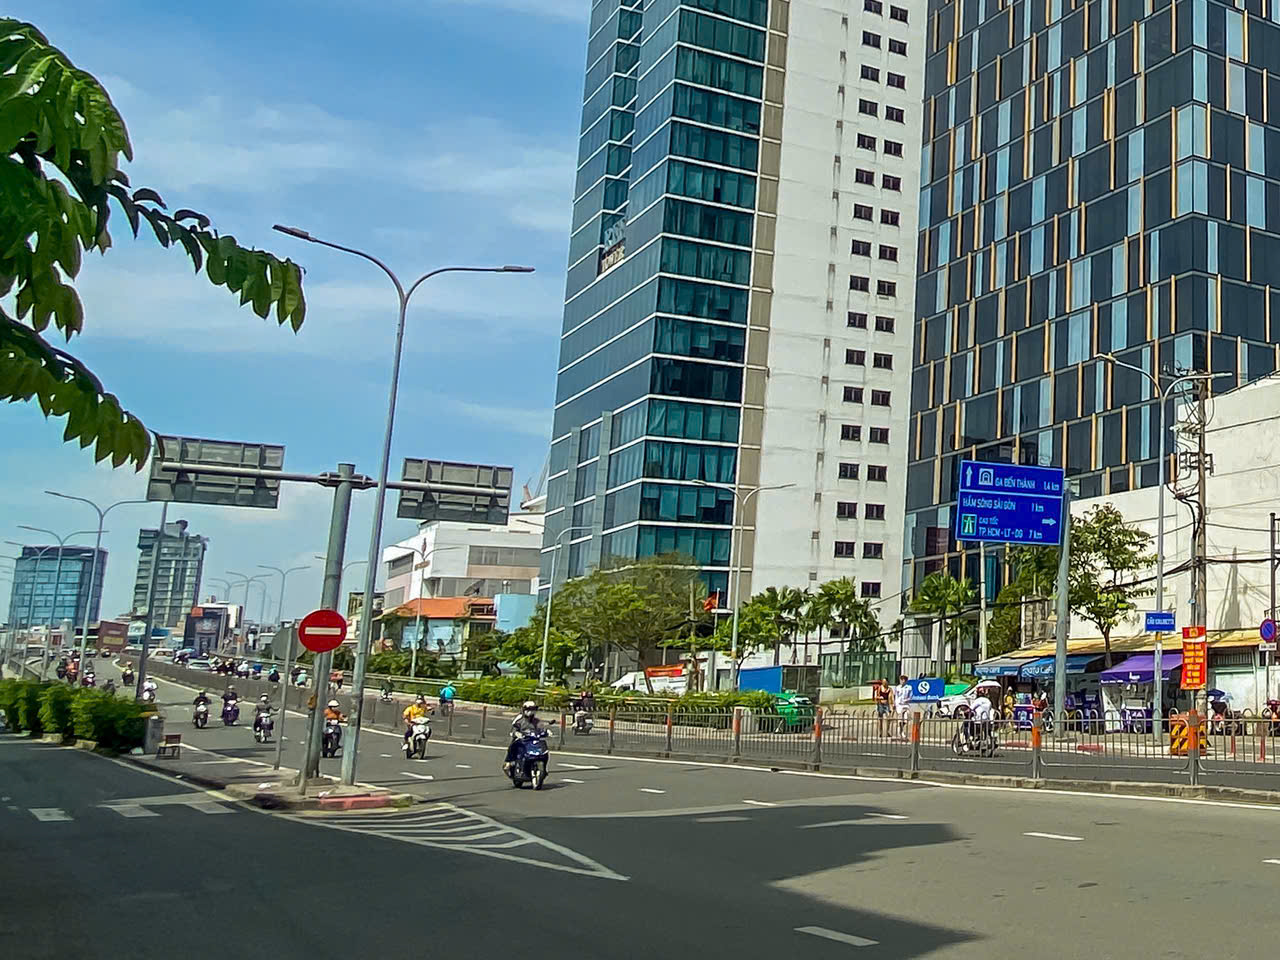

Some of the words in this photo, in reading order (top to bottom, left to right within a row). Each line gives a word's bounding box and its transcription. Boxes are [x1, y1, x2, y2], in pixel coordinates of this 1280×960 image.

[995, 477, 1002, 487] GA
[1004, 476, 1016, 487] BẾN
[1017, 477, 1036, 489] THÀNH
[1051, 481, 1060, 491] km
[962, 495, 976, 507] HẦM
[977, 496, 992, 509] SÔNG
[993, 497, 1003, 510] SÀI
[1004, 498, 1016, 510] GÒN
[1035, 503, 1044, 512] km
